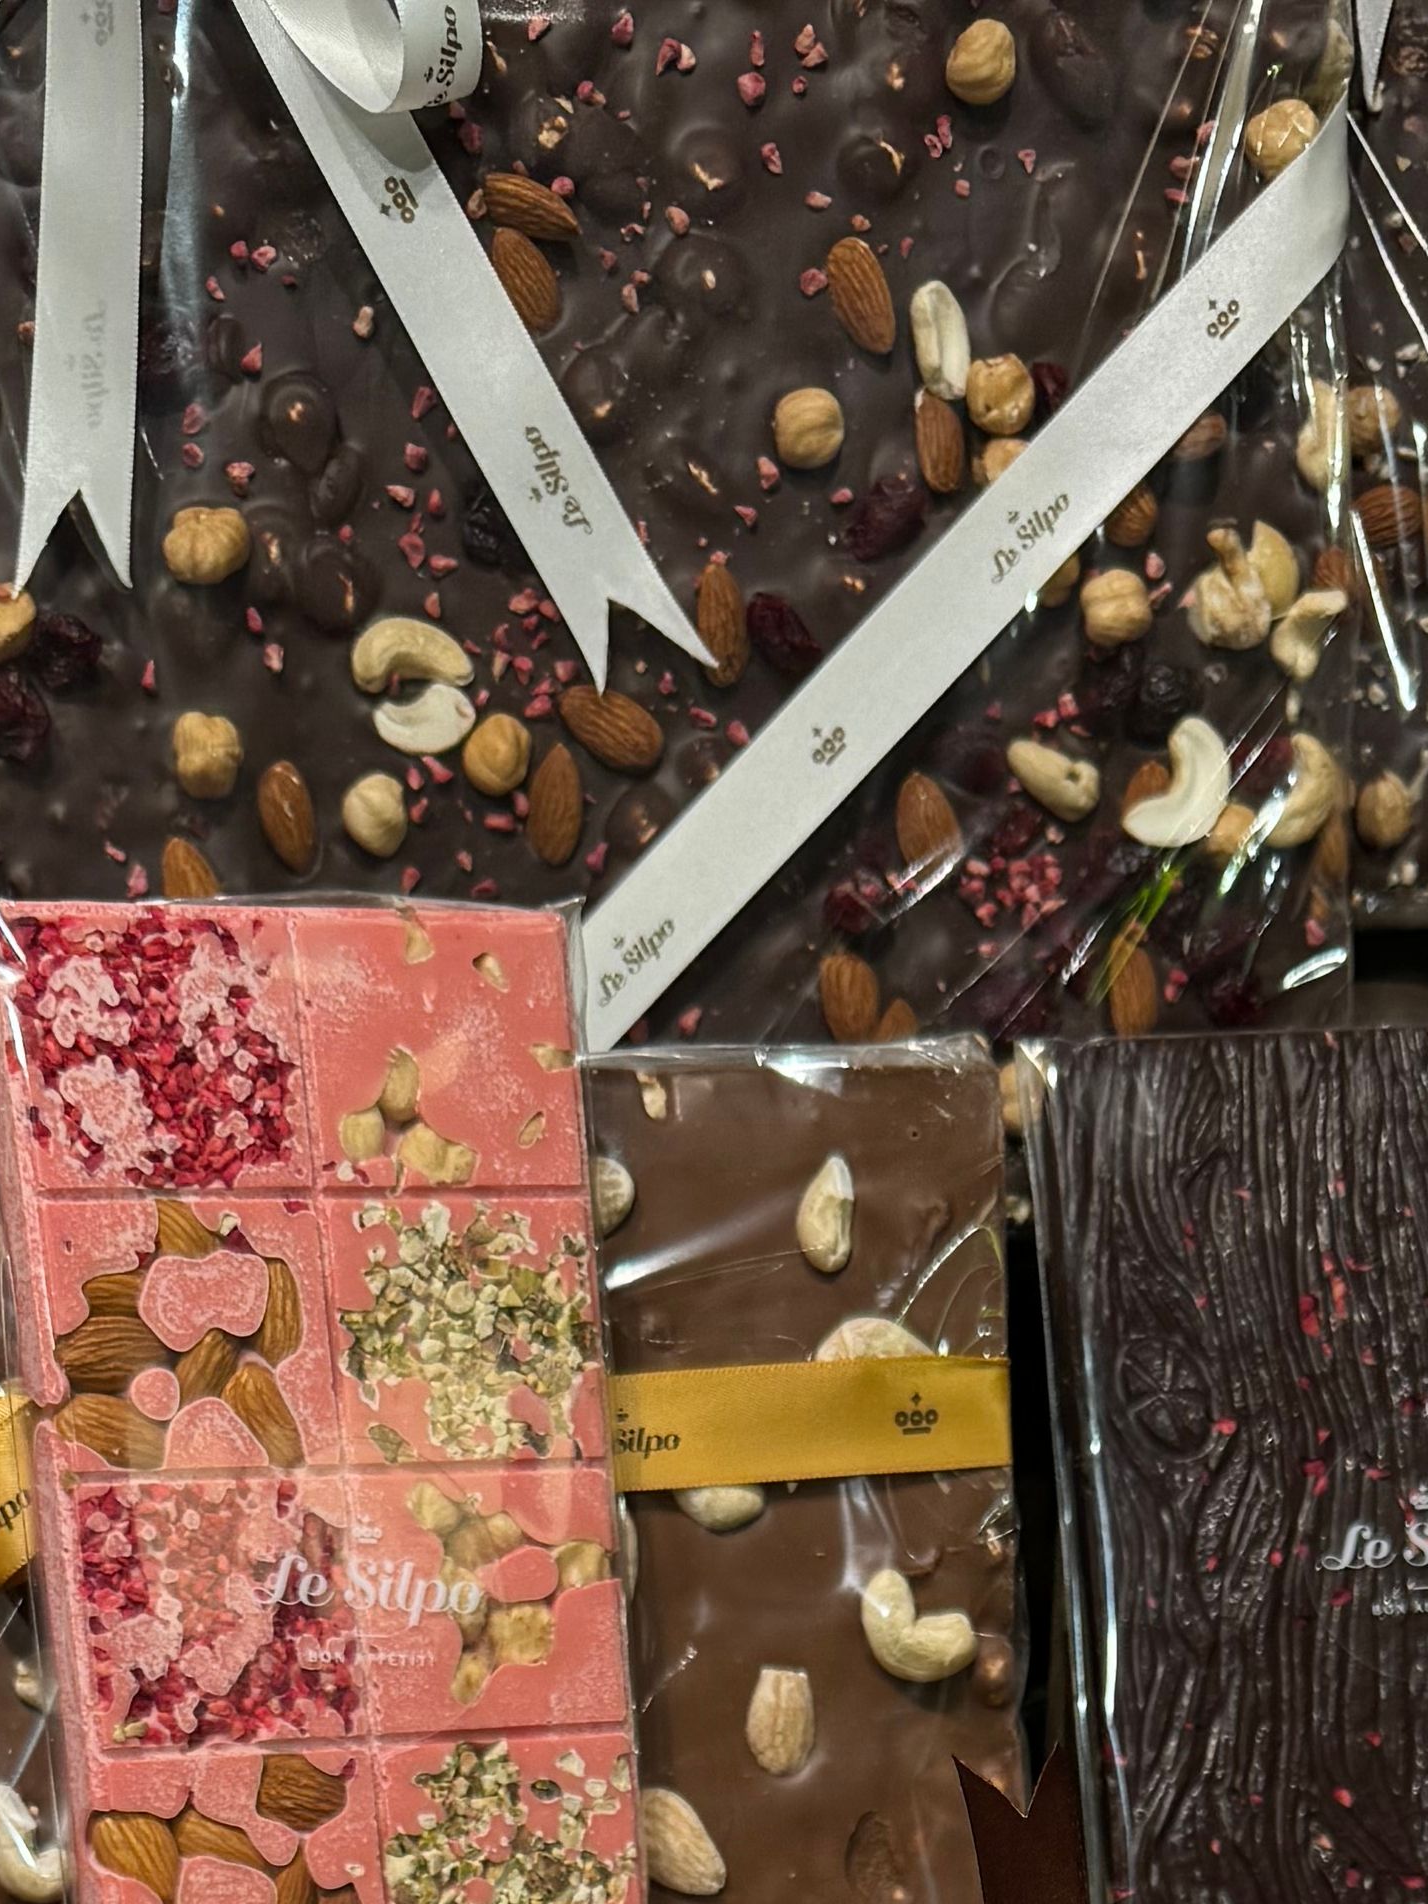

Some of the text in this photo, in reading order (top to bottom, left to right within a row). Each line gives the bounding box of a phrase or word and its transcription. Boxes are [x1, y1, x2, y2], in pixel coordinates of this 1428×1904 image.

[435, 4, 463, 87] Silpo
[525, 426, 593, 535] Le Silpo
[991, 493, 1070, 584] Le Silpo
[598, 918, 675, 1008] Le Silpo
[252, 1553, 484, 1628] Le Silpo
[1322, 1524, 1398, 1571] Le
